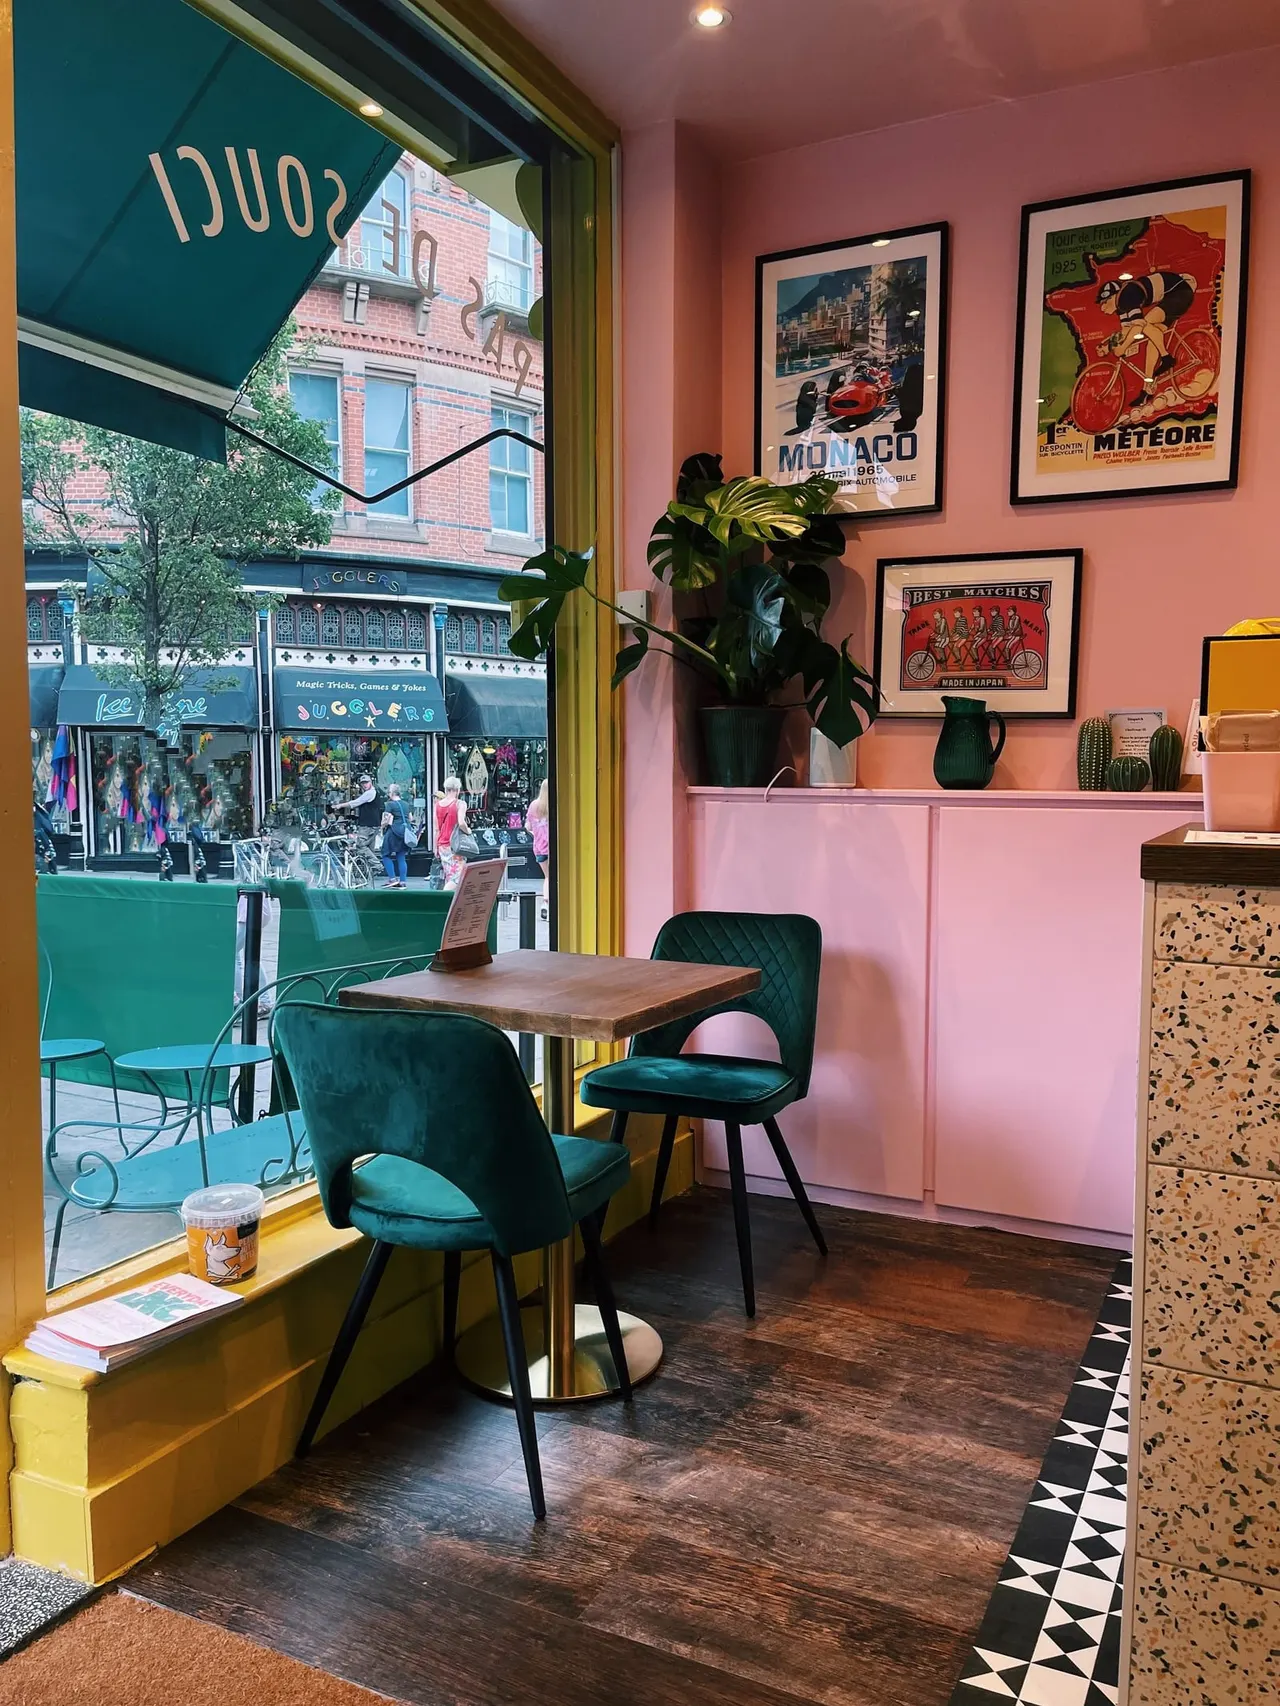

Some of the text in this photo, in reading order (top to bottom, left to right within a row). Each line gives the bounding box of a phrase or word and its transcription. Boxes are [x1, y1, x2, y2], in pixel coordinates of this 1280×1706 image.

[1052, 225, 1132, 248] Tour de France
[1051, 259, 1077, 275] 1925
[779, 432, 918, 473] MONACO
[1039, 442, 1083, 452] DESPONTIN
[852, 464, 884, 476] 1965
[855, 474, 917, 486] AUTOMOBILE
[313, 570, 401, 592] JUGGLERS
[912, 587, 1040, 605] BEST MATCHES
[908, 618, 1044, 637] TRADE MARK
[296, 680, 426, 692] Magic Tricks, Games & Jokes
[942, 678, 965, 687] MADE
[975, 678, 1004, 687] JAPAN
[96, 693, 133, 722] Ice
[297, 698, 435, 722] JUGGLERS
